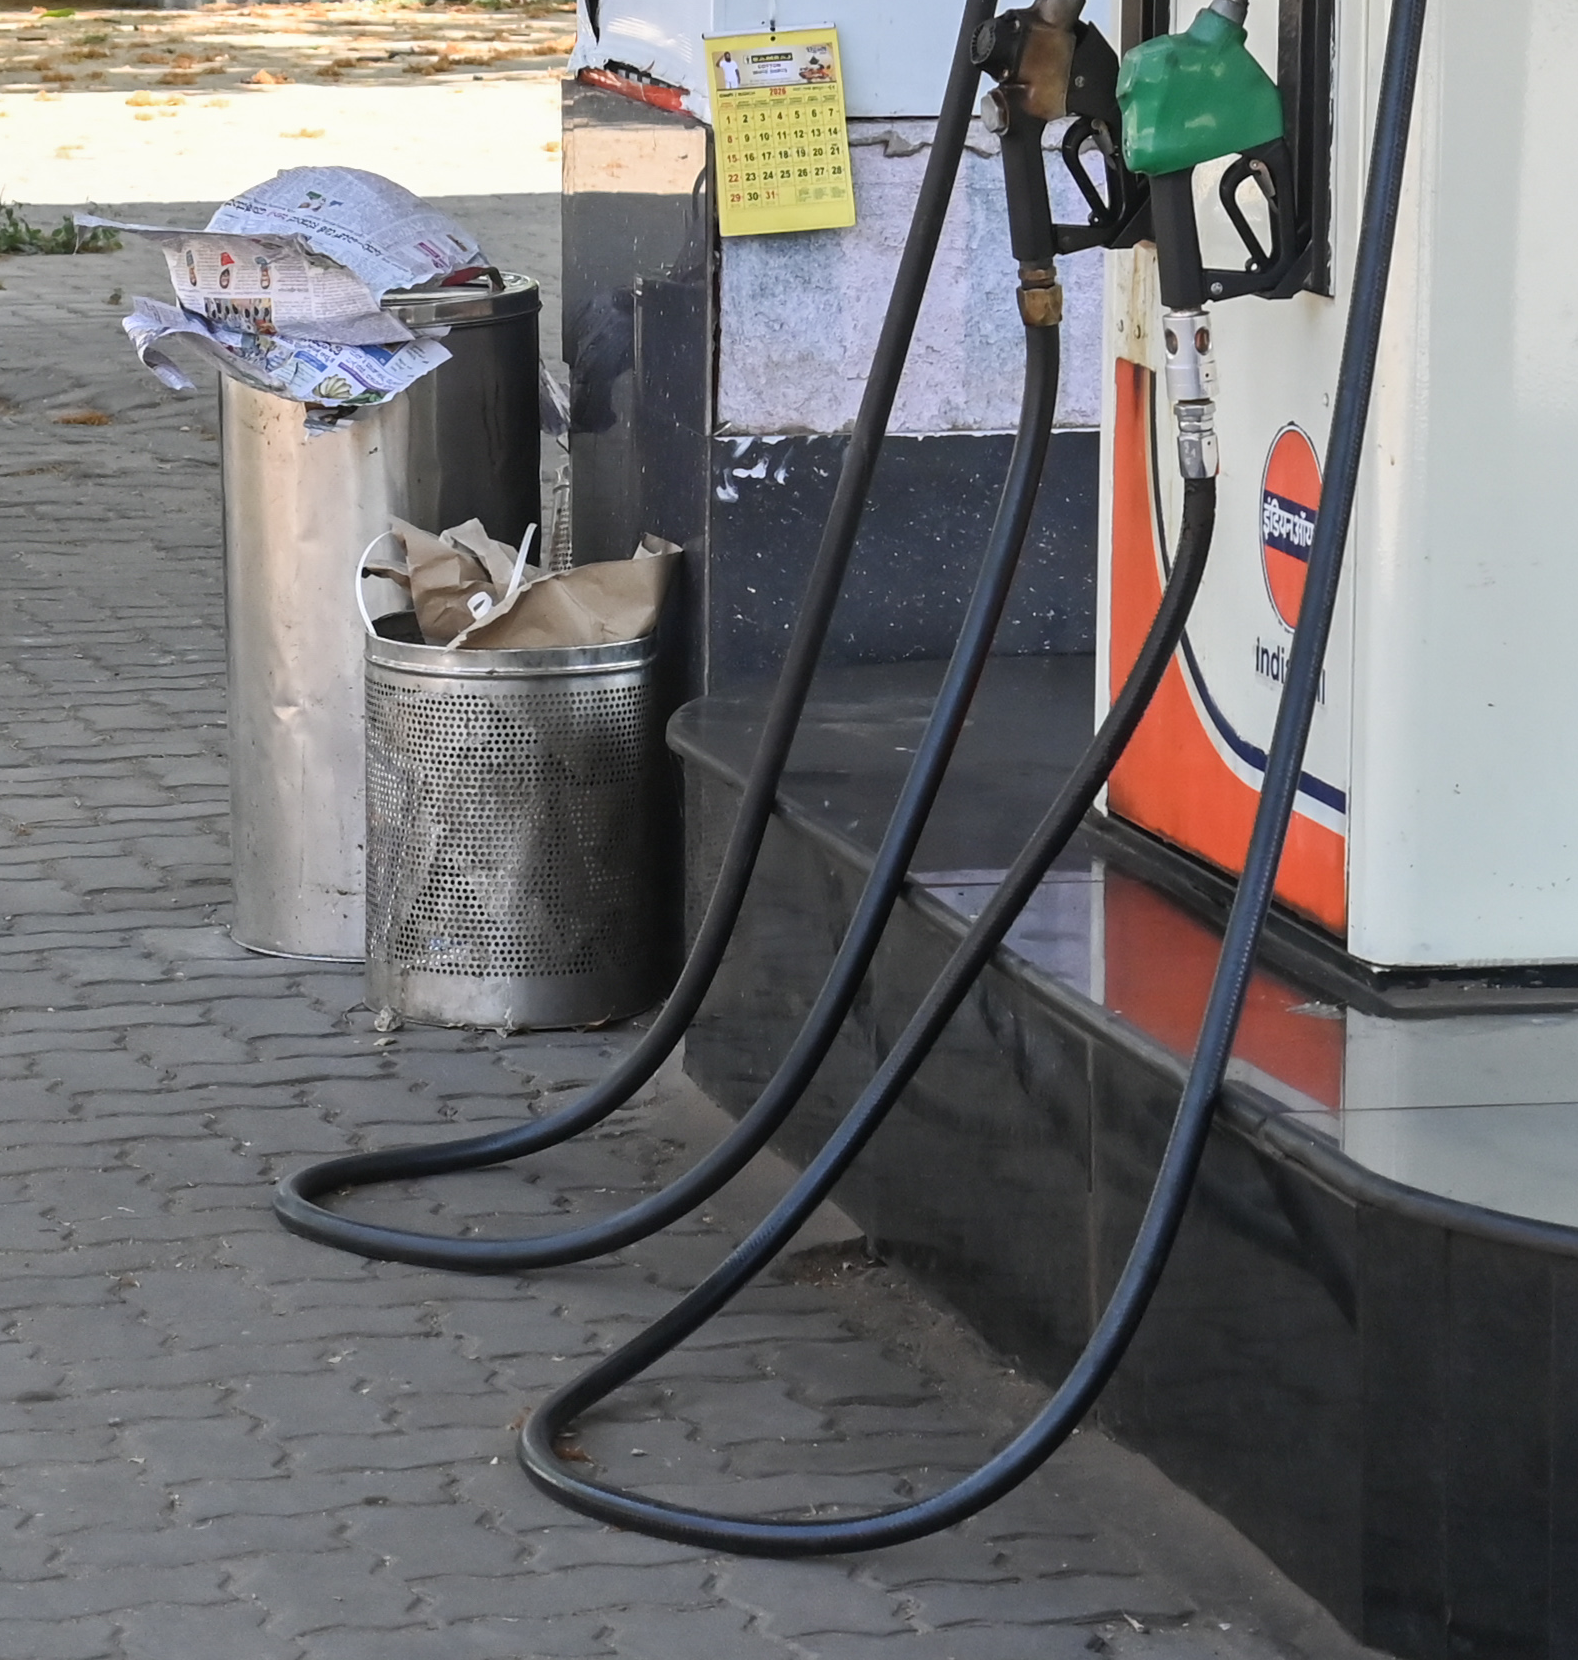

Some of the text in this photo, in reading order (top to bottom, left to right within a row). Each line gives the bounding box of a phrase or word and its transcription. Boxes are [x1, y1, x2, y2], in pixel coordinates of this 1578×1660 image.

[769, 86, 787, 96] 2026
[726, 108, 833, 124] 1 2 3 4 5 6 7
[728, 127, 838, 143] 8 9 10 11 12 13 14
[727, 147, 839, 163] 15 16 17 18 19 20 21
[728, 166, 842, 183] 22 23 24 25 26 27 28
[730, 191, 775, 202] 29 30 31
[1264, 496, 1315, 547] इंडियनऑय
